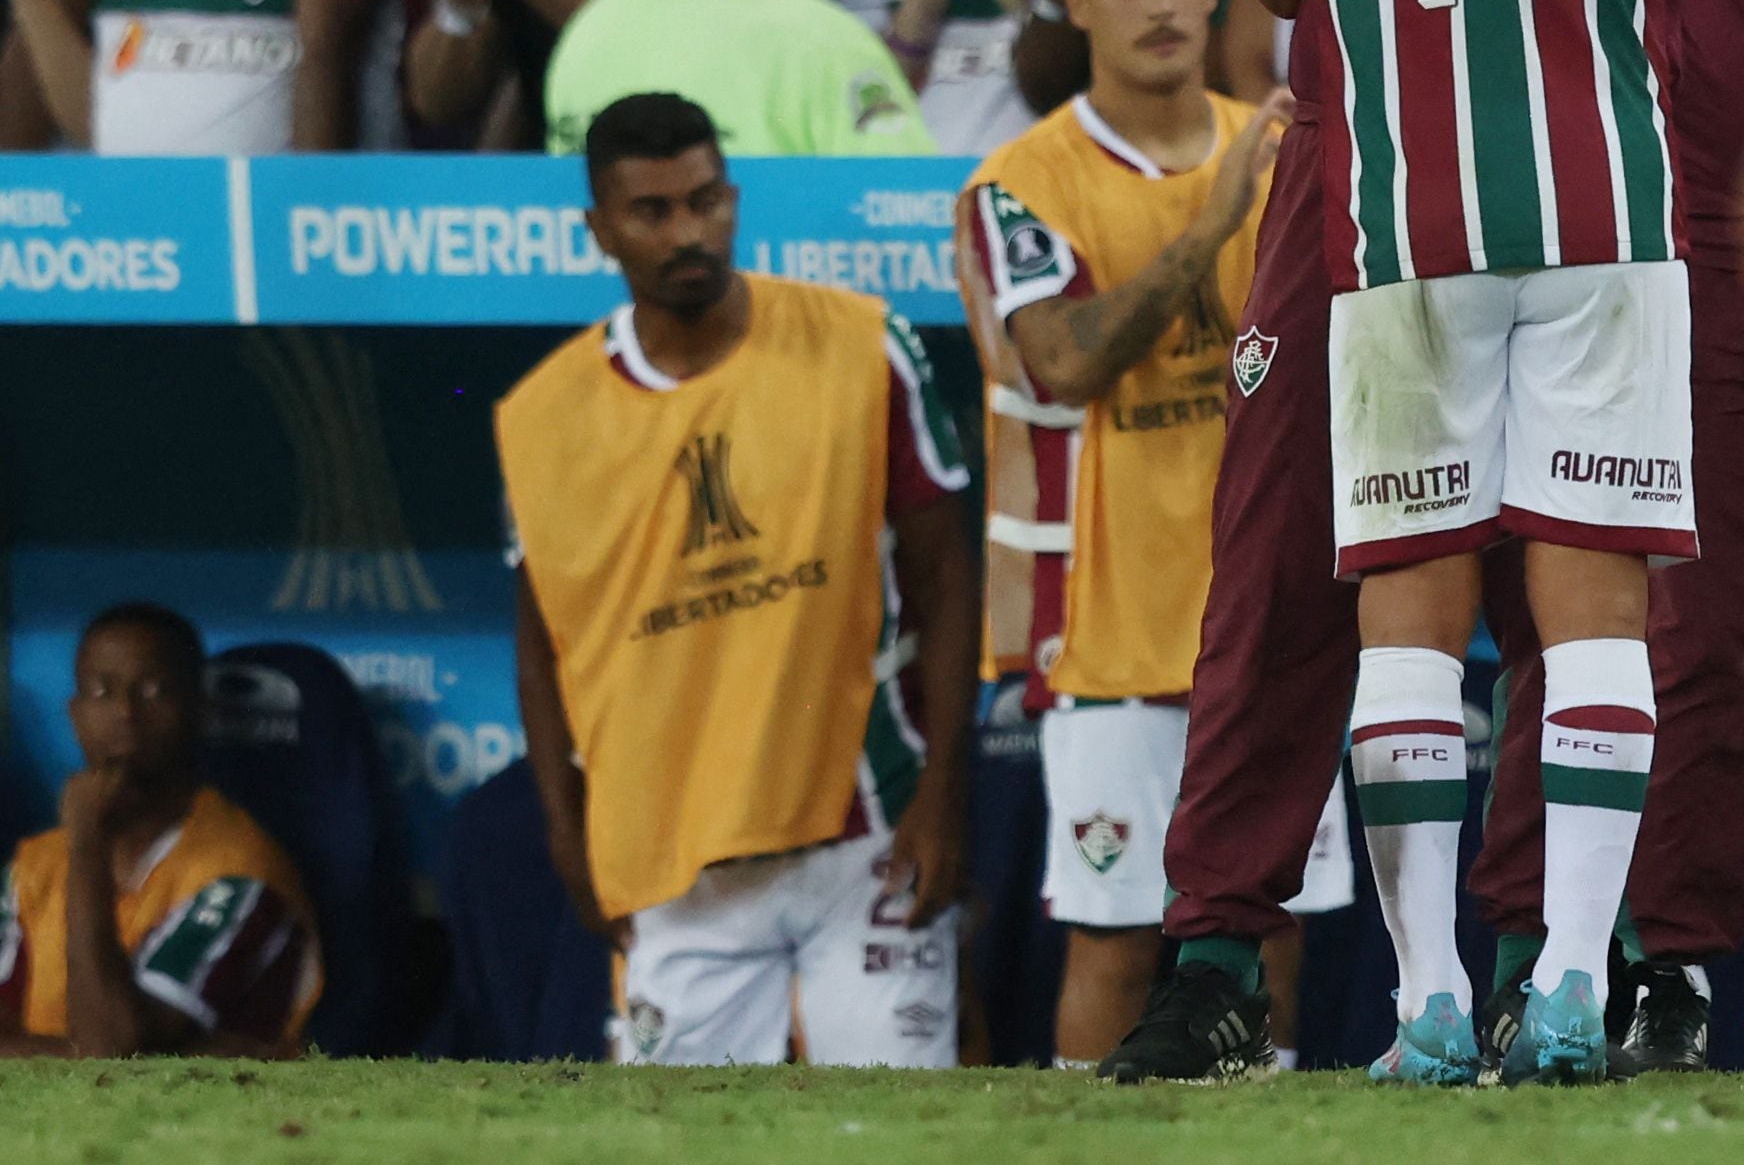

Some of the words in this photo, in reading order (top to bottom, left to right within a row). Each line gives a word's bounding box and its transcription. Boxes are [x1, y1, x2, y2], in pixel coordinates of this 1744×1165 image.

[289, 205, 624, 276] POWERAD
[1404, 492, 1471, 516] RECOVERY
[1392, 749, 1448, 762] FFC
[1557, 738, 1613, 755] FFC
